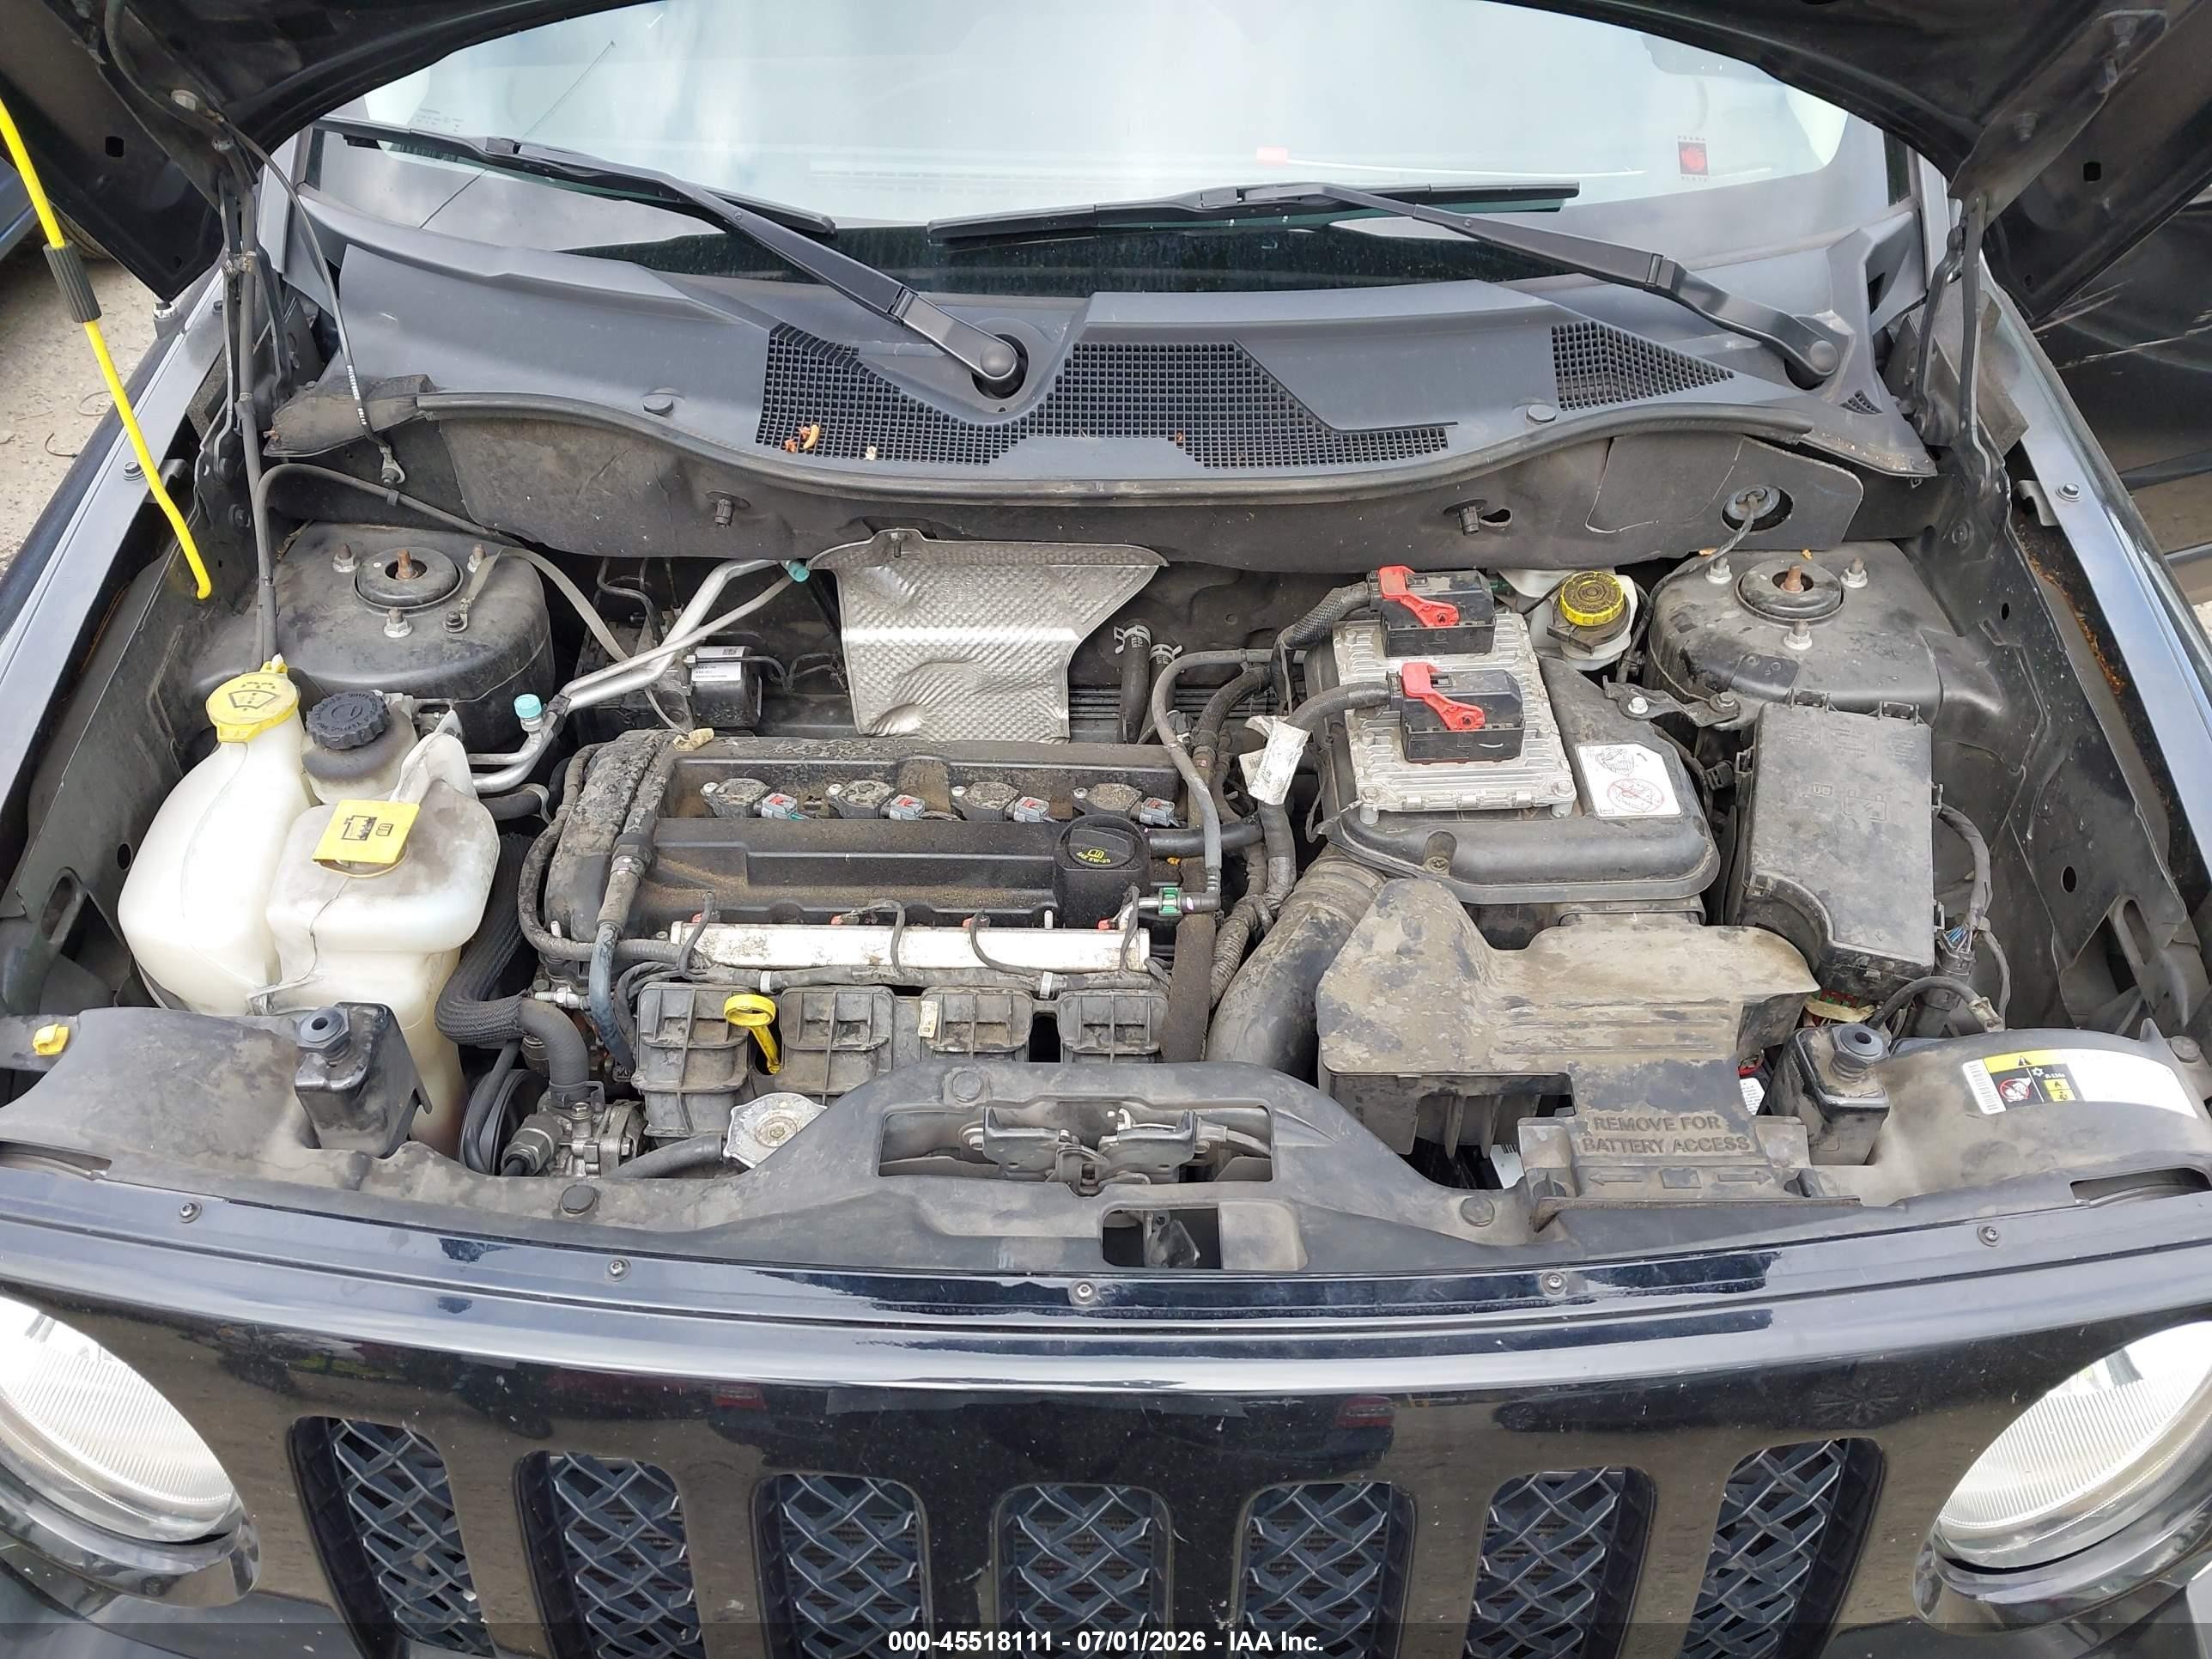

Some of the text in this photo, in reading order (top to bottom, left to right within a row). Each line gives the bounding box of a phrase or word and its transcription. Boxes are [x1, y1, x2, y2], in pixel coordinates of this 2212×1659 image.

[1594, 1115, 1721, 1132] REMOVE FOR
[1582, 1136, 1750, 1153] BATTERY ACCESS
